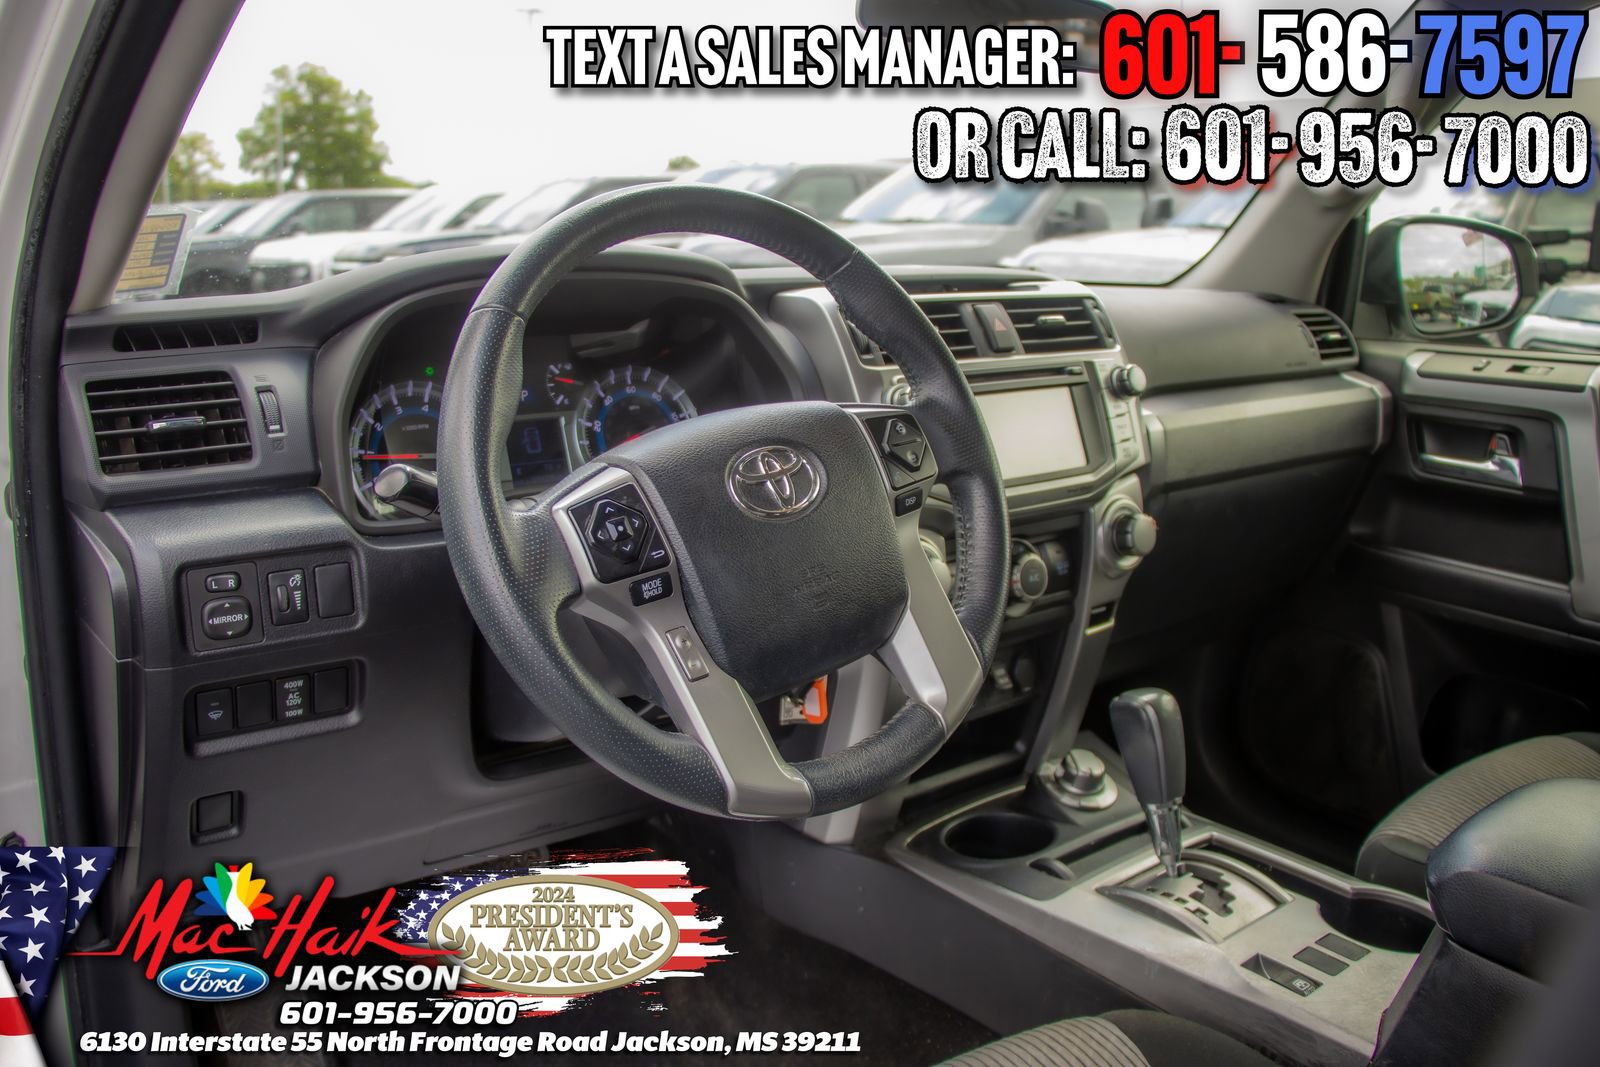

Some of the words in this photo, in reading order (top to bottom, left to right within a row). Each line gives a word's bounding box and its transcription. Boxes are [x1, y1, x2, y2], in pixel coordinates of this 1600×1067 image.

[395, 406, 403, 415] 3
[421, 404, 429, 412] 4
[374, 422, 383, 432] 2
[212, 580, 218, 589] L
[228, 579, 235, 588] R
[641, 578, 662, 591] MODE
[649, 587, 663, 597] HOLD
[213, 613, 244, 625] MIRROR
[284, 680, 304, 689] 400W
[288, 692, 300, 700] AC
[286, 698, 302, 706] 120V
[285, 709, 304, 718] 100W
